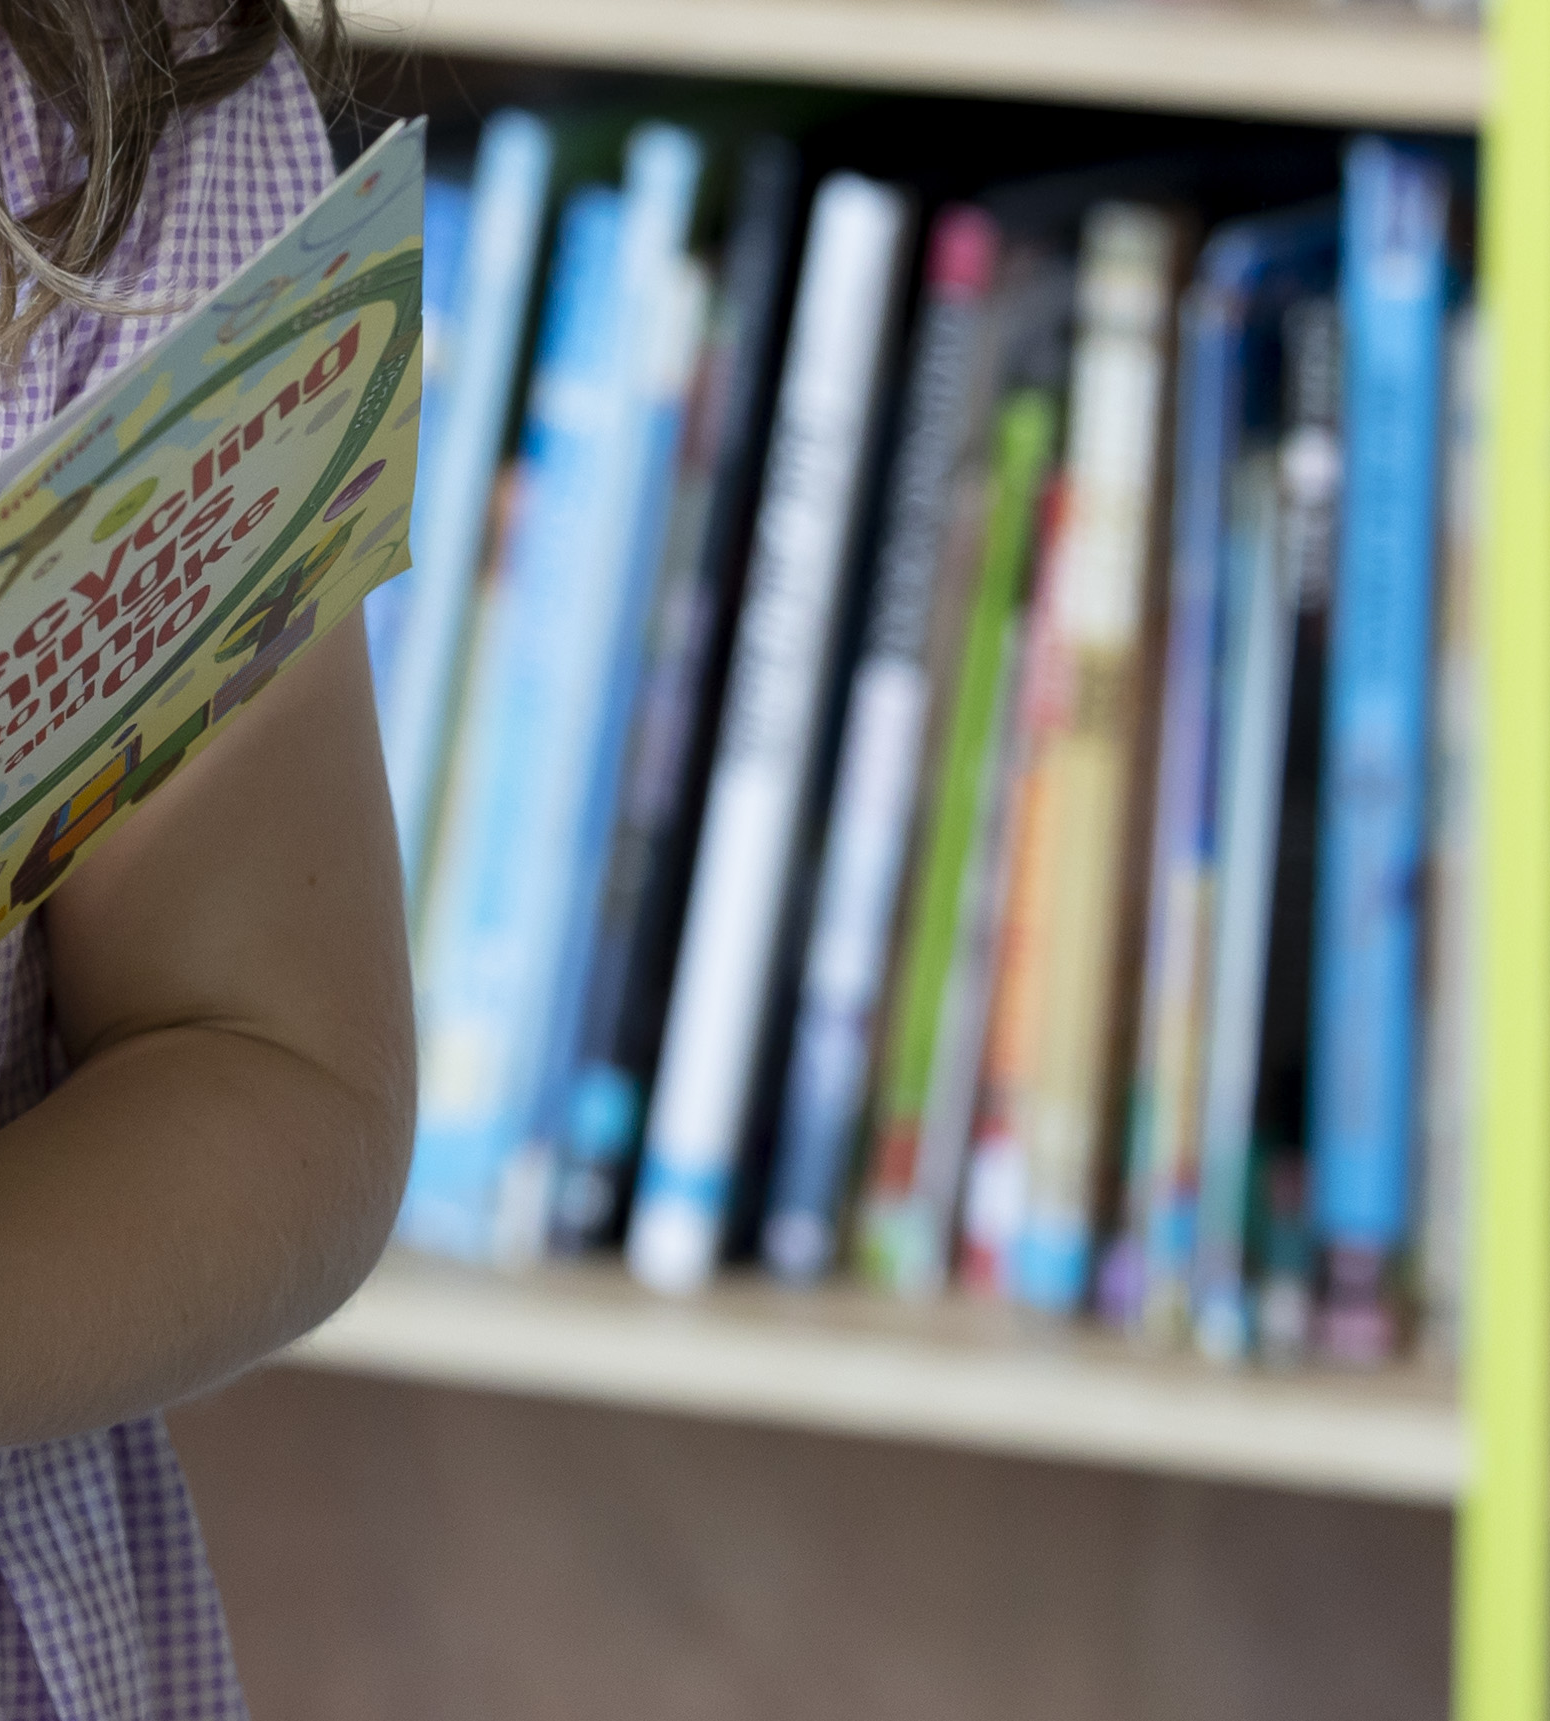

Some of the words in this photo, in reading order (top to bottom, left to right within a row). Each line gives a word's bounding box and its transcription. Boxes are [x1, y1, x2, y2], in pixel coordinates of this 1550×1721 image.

[4, 679, 95, 773] and
[102, 584, 211, 698] do
[50, 486, 280, 712] make
